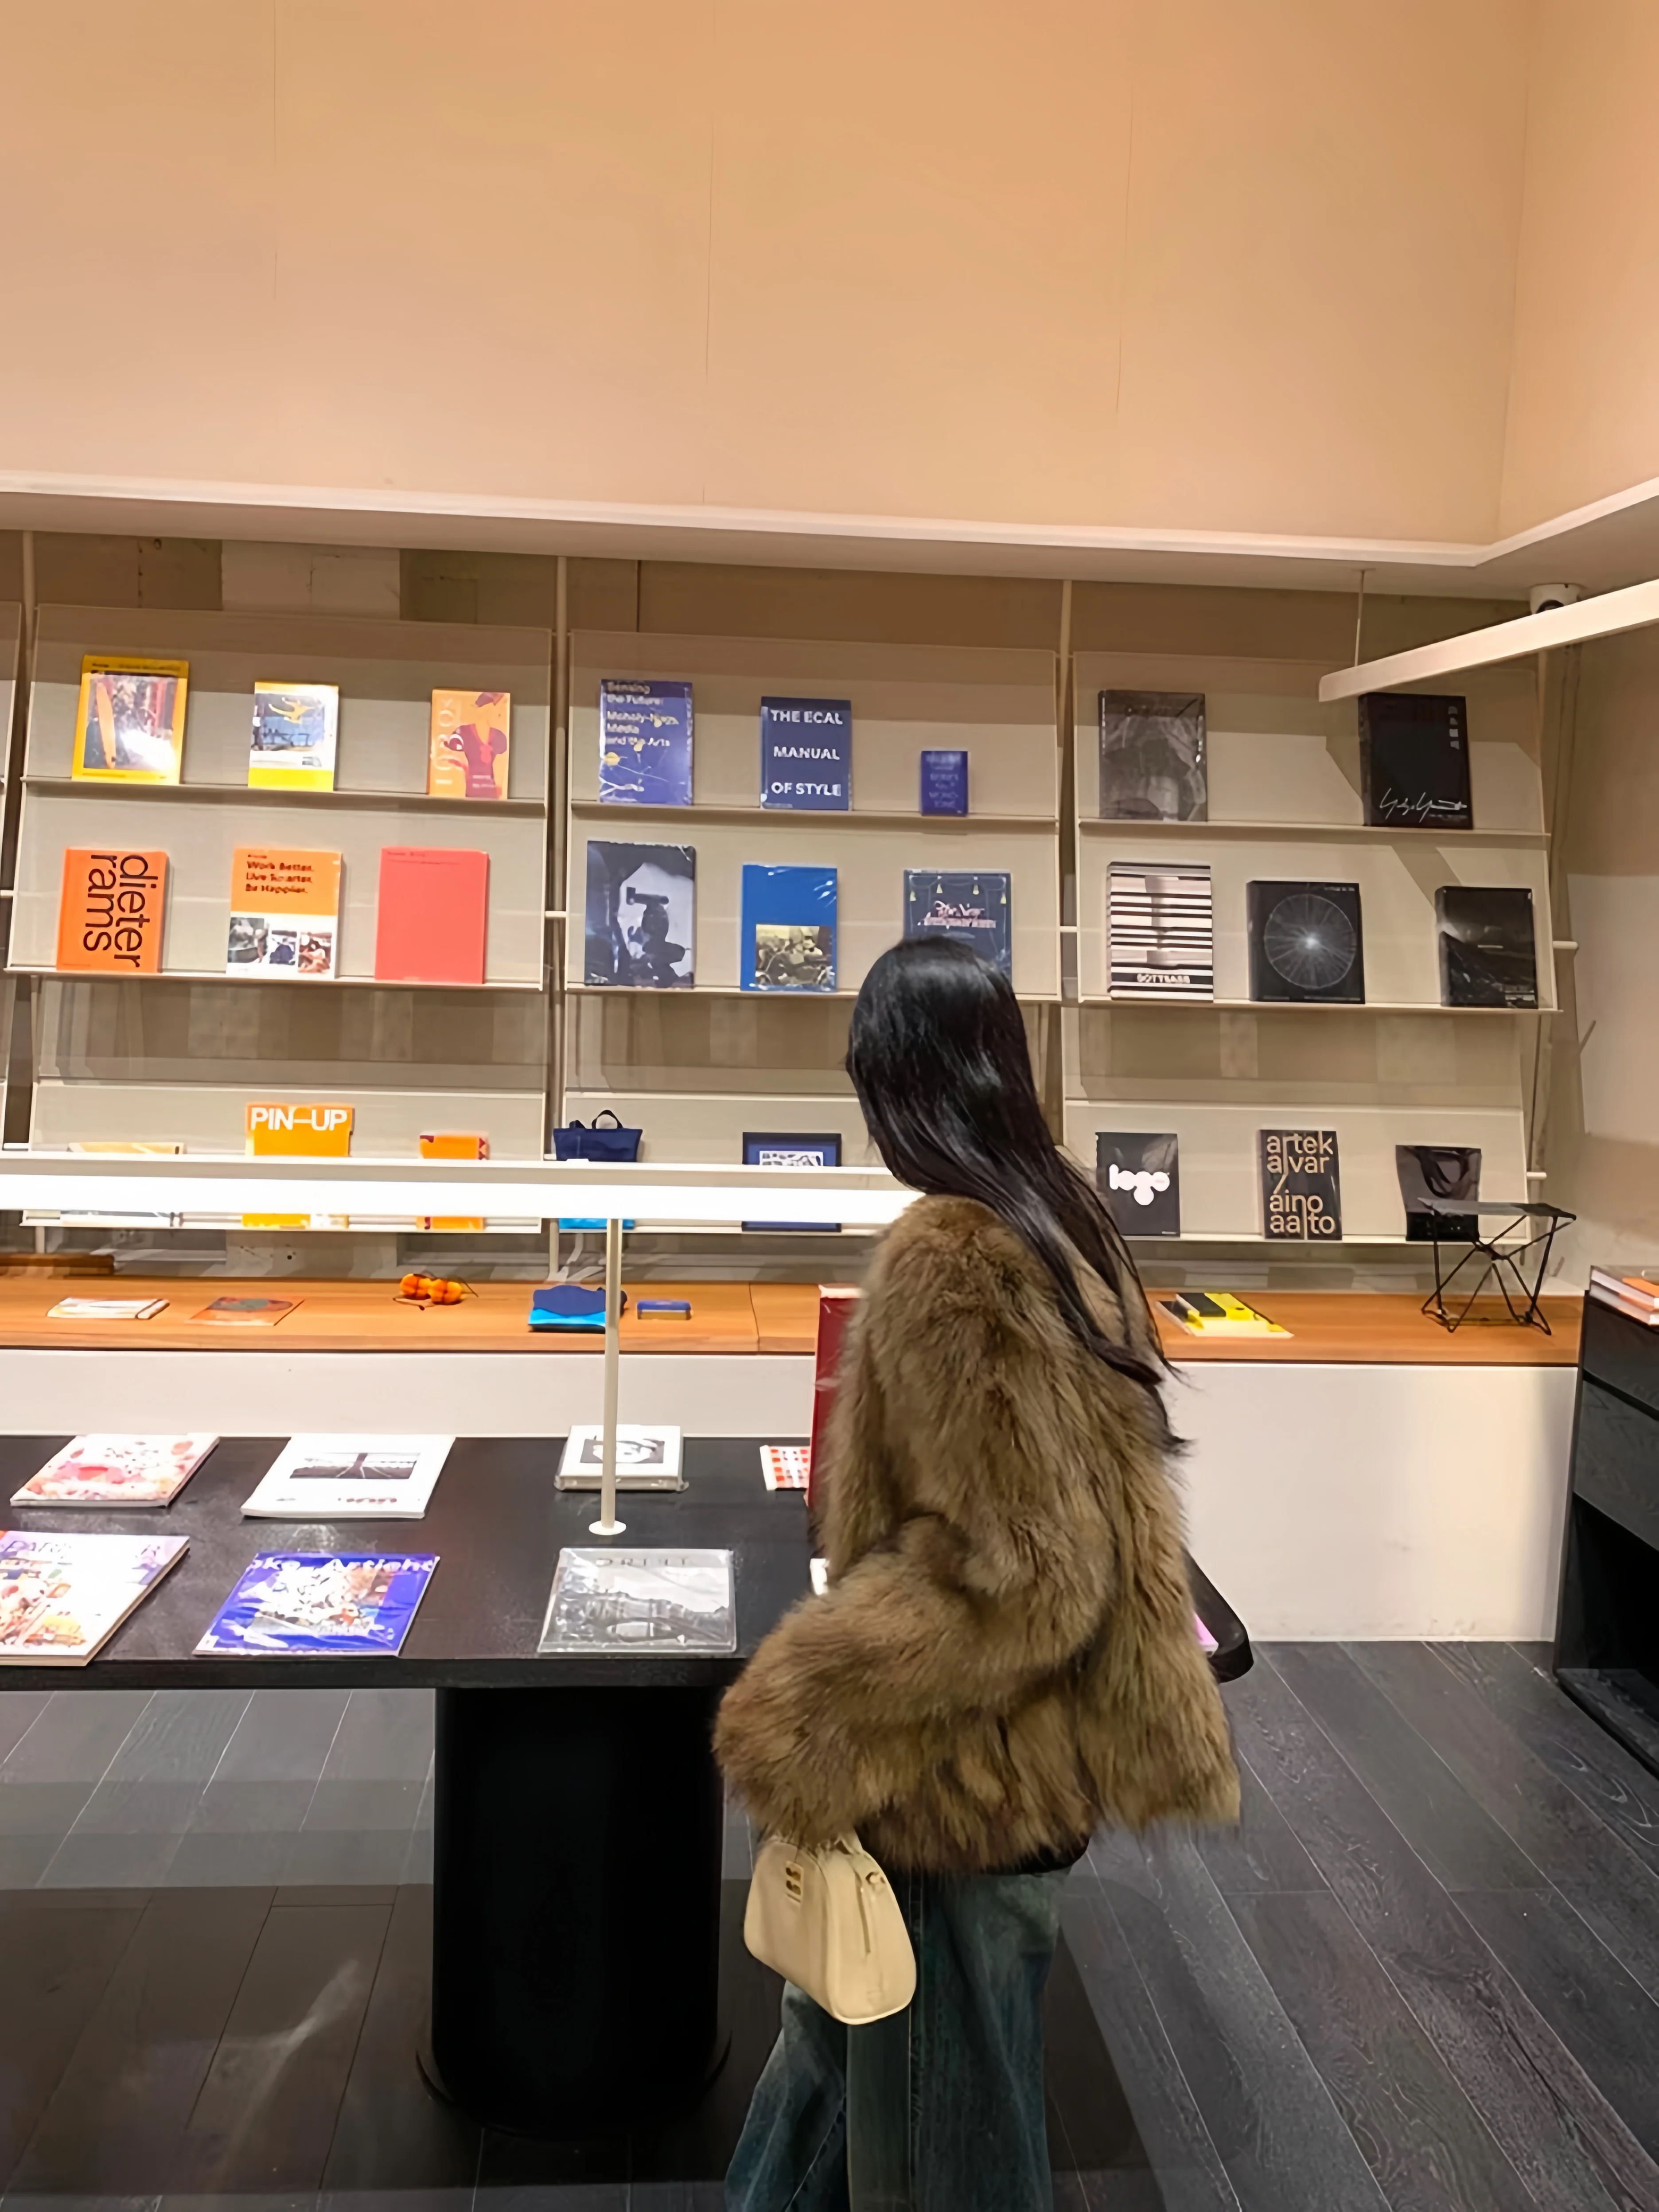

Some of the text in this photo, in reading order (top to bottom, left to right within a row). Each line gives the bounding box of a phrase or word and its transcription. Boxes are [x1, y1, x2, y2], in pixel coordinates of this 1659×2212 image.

[770, 709, 843, 725] THE ECAL
[774, 746, 840, 760] MANUAL
[771, 782, 841, 797] OF STYLE
[83, 854, 117, 951] rams
[114, 854, 158, 968] dieter
[251, 1106, 347, 1131] PIN-UP
[1266, 1131, 1333, 1155] artek
[1270, 1189, 1324, 1214] aino
[1270, 1212, 1336, 1240] aalto
